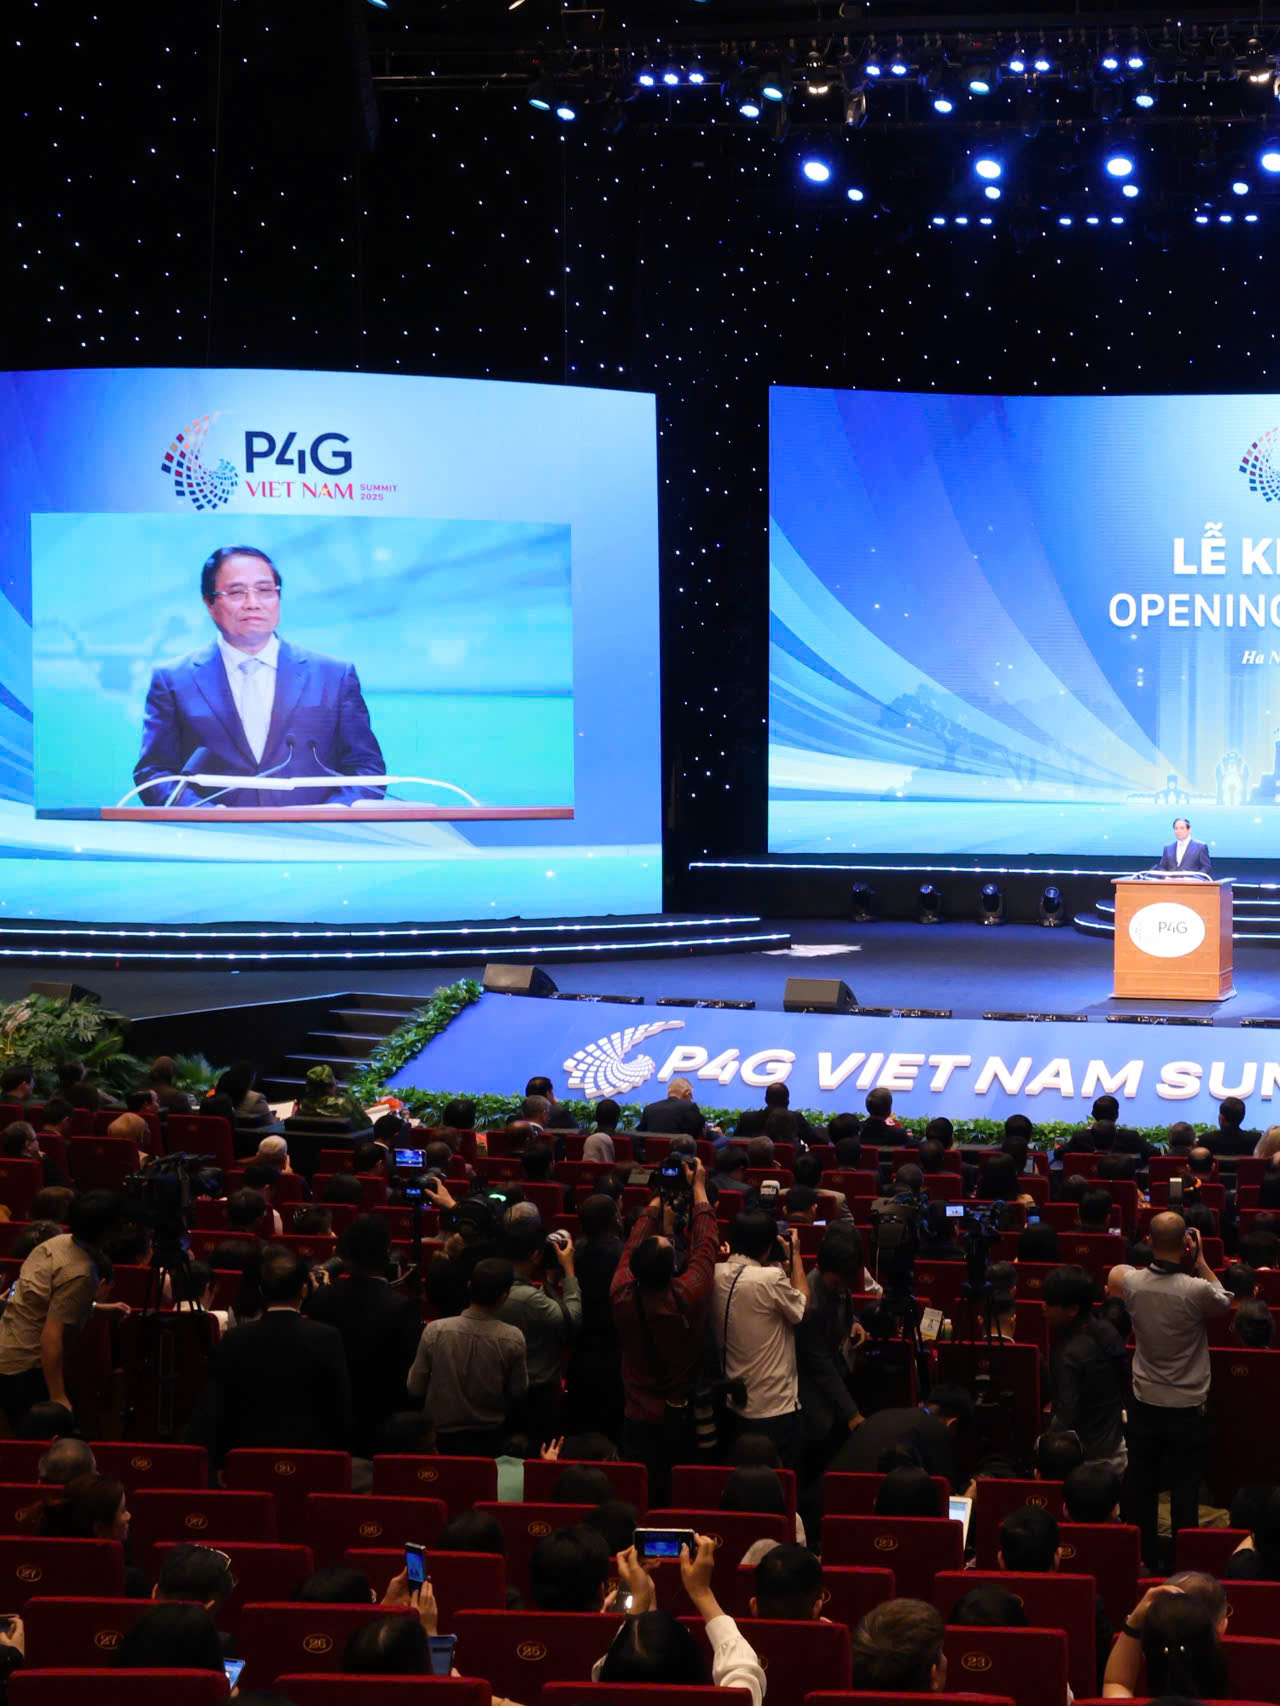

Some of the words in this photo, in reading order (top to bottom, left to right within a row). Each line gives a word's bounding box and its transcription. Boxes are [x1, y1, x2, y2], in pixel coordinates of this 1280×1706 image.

[245, 431, 353, 475] P4G
[245, 480, 295, 498] VIET
[302, 481, 355, 500] NAM
[360, 484, 397, 492] SUMMIT
[1173, 522, 1227, 575] LỄ
[1241, 650, 1265, 665] Ha
[1158, 921, 1188, 934] P4G
[657, 1045, 796, 1087] P4G
[817, 1052, 971, 1092] VIET
[974, 1056, 1144, 1098] NAM
